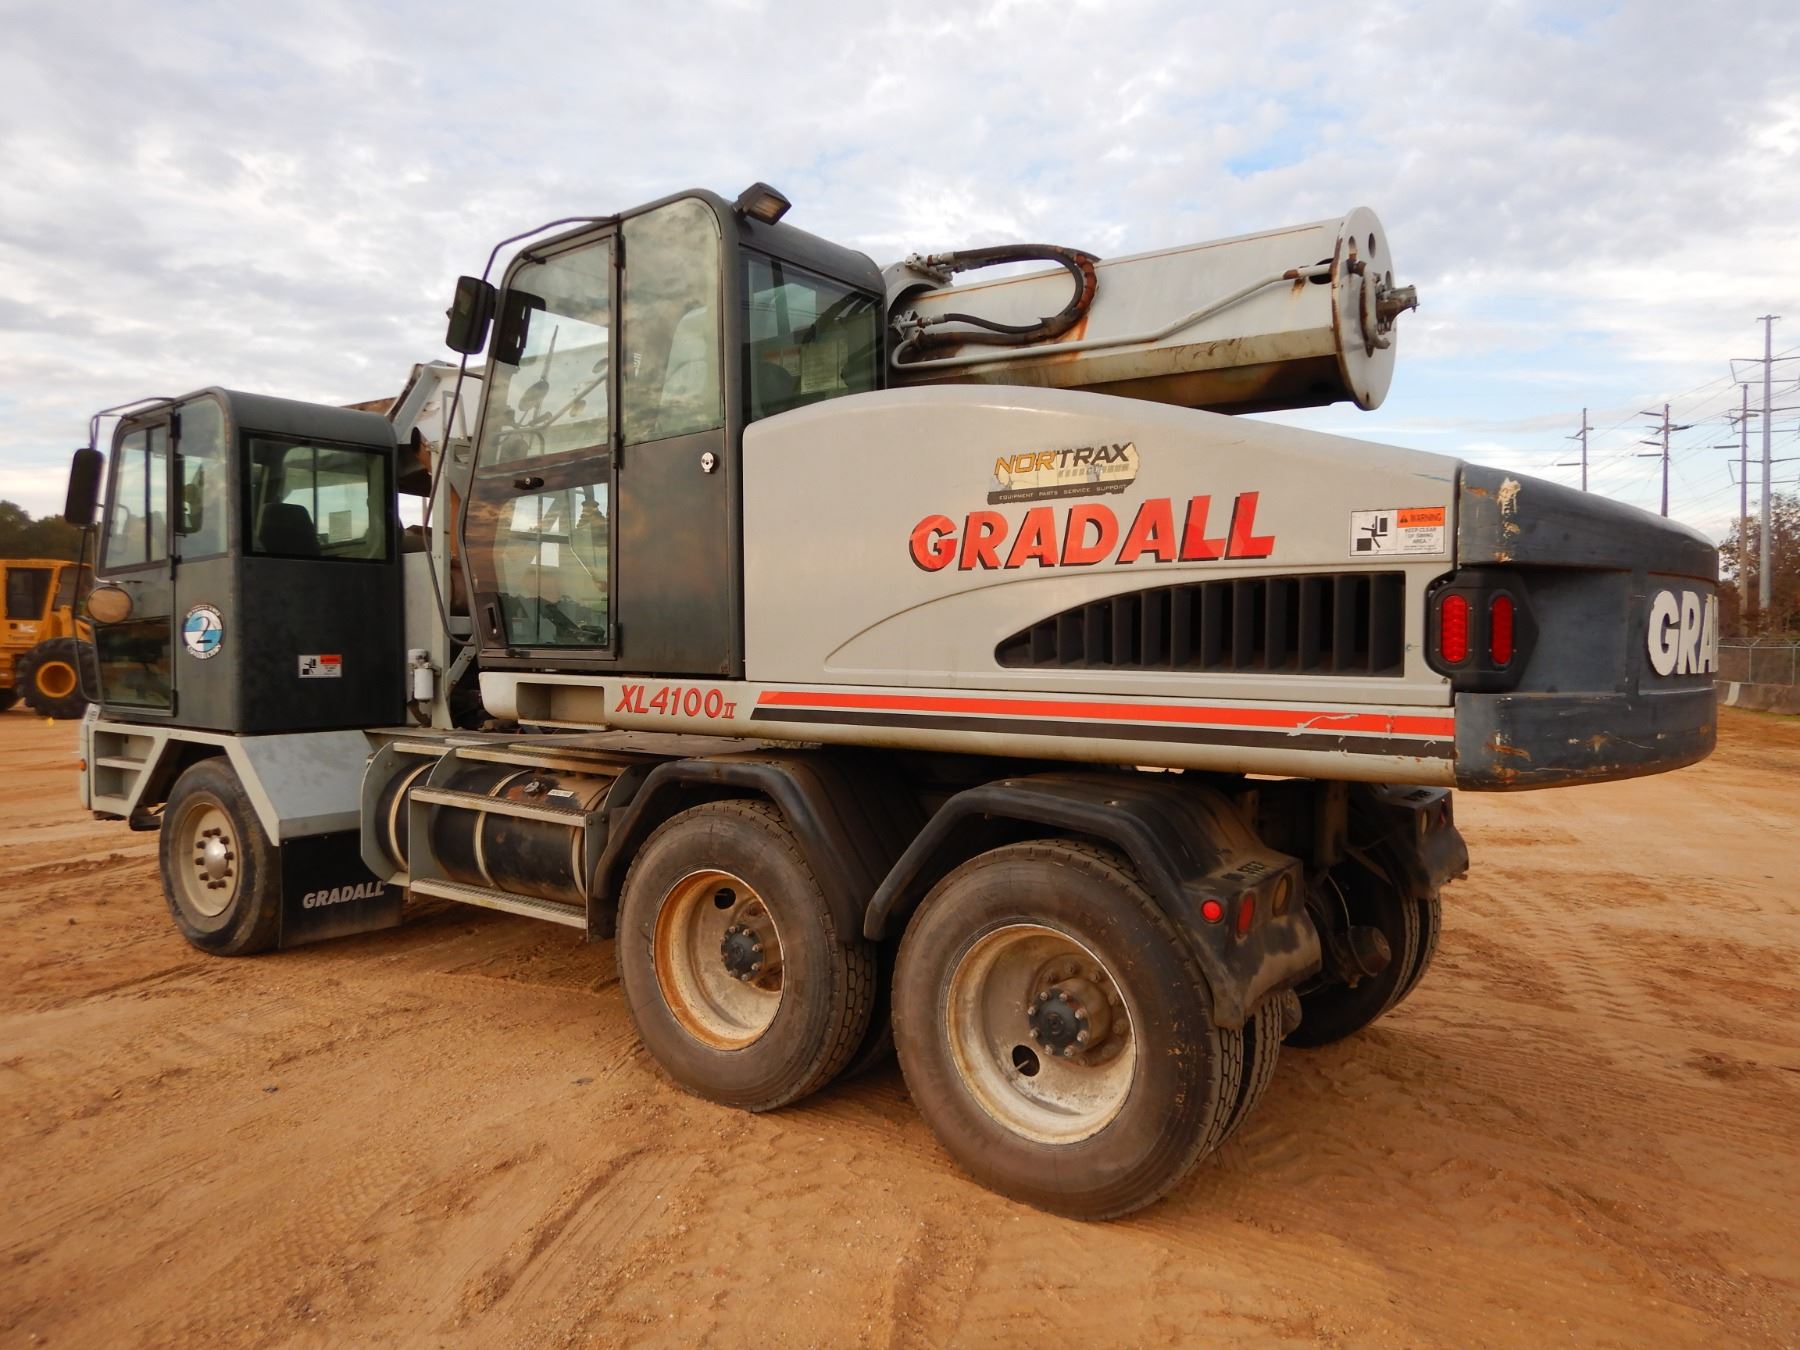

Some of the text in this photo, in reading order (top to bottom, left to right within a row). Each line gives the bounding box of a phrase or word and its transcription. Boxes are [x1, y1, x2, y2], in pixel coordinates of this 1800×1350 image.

[994, 442, 1133, 475] NORTRAX
[999, 491, 1034, 501] EQUIPMENT
[1063, 487, 1091, 495] SERVICE
[1096, 484, 1127, 492] SUPPORT
[909, 491, 1276, 572] GRADALL
[1410, 513, 1442, 522] WARNING
[194, 616, 213, 644] 2
[302, 880, 385, 909] GRADALL
